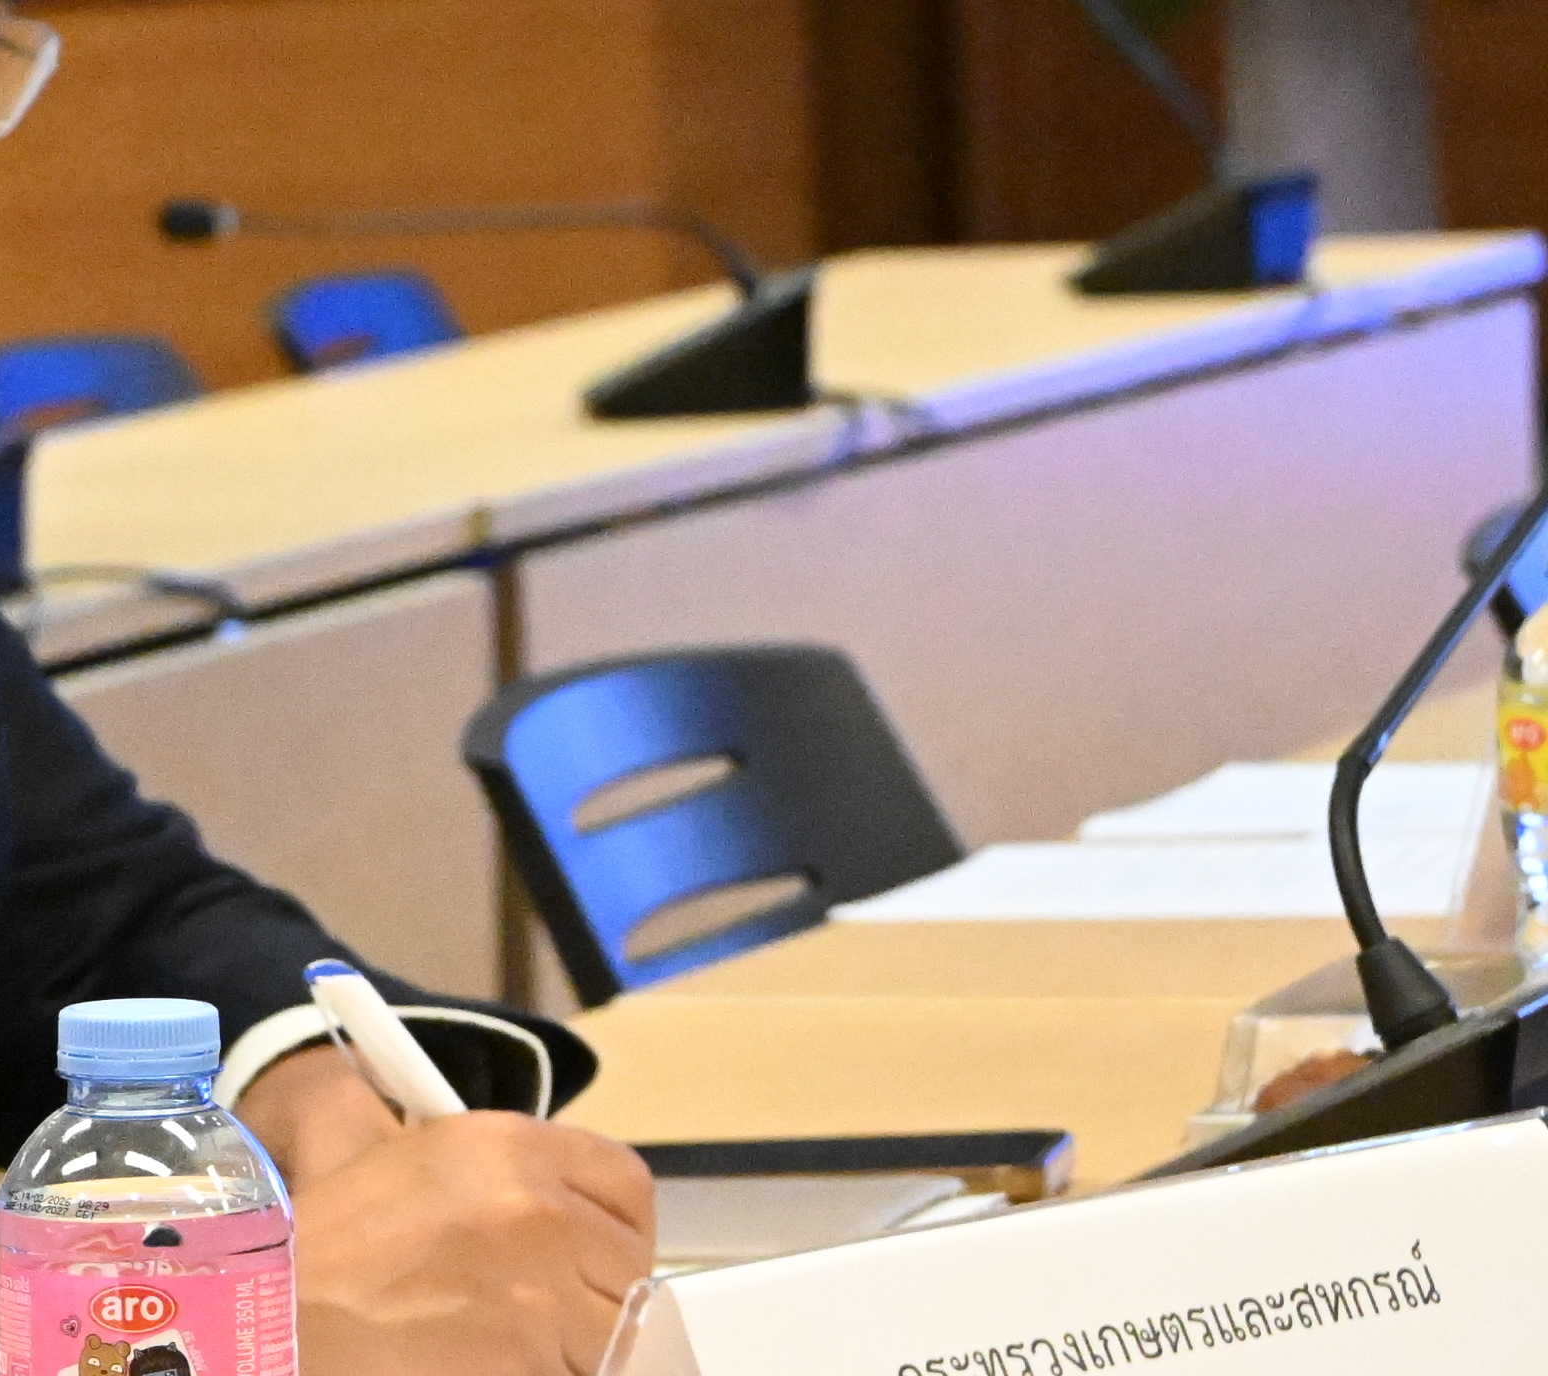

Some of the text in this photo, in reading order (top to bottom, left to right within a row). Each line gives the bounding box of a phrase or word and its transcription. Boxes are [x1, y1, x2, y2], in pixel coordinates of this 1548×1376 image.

[235, 1277, 255, 1298] ML
[101, 1295, 164, 1321] aro
[235, 1300, 255, 1325] 350
